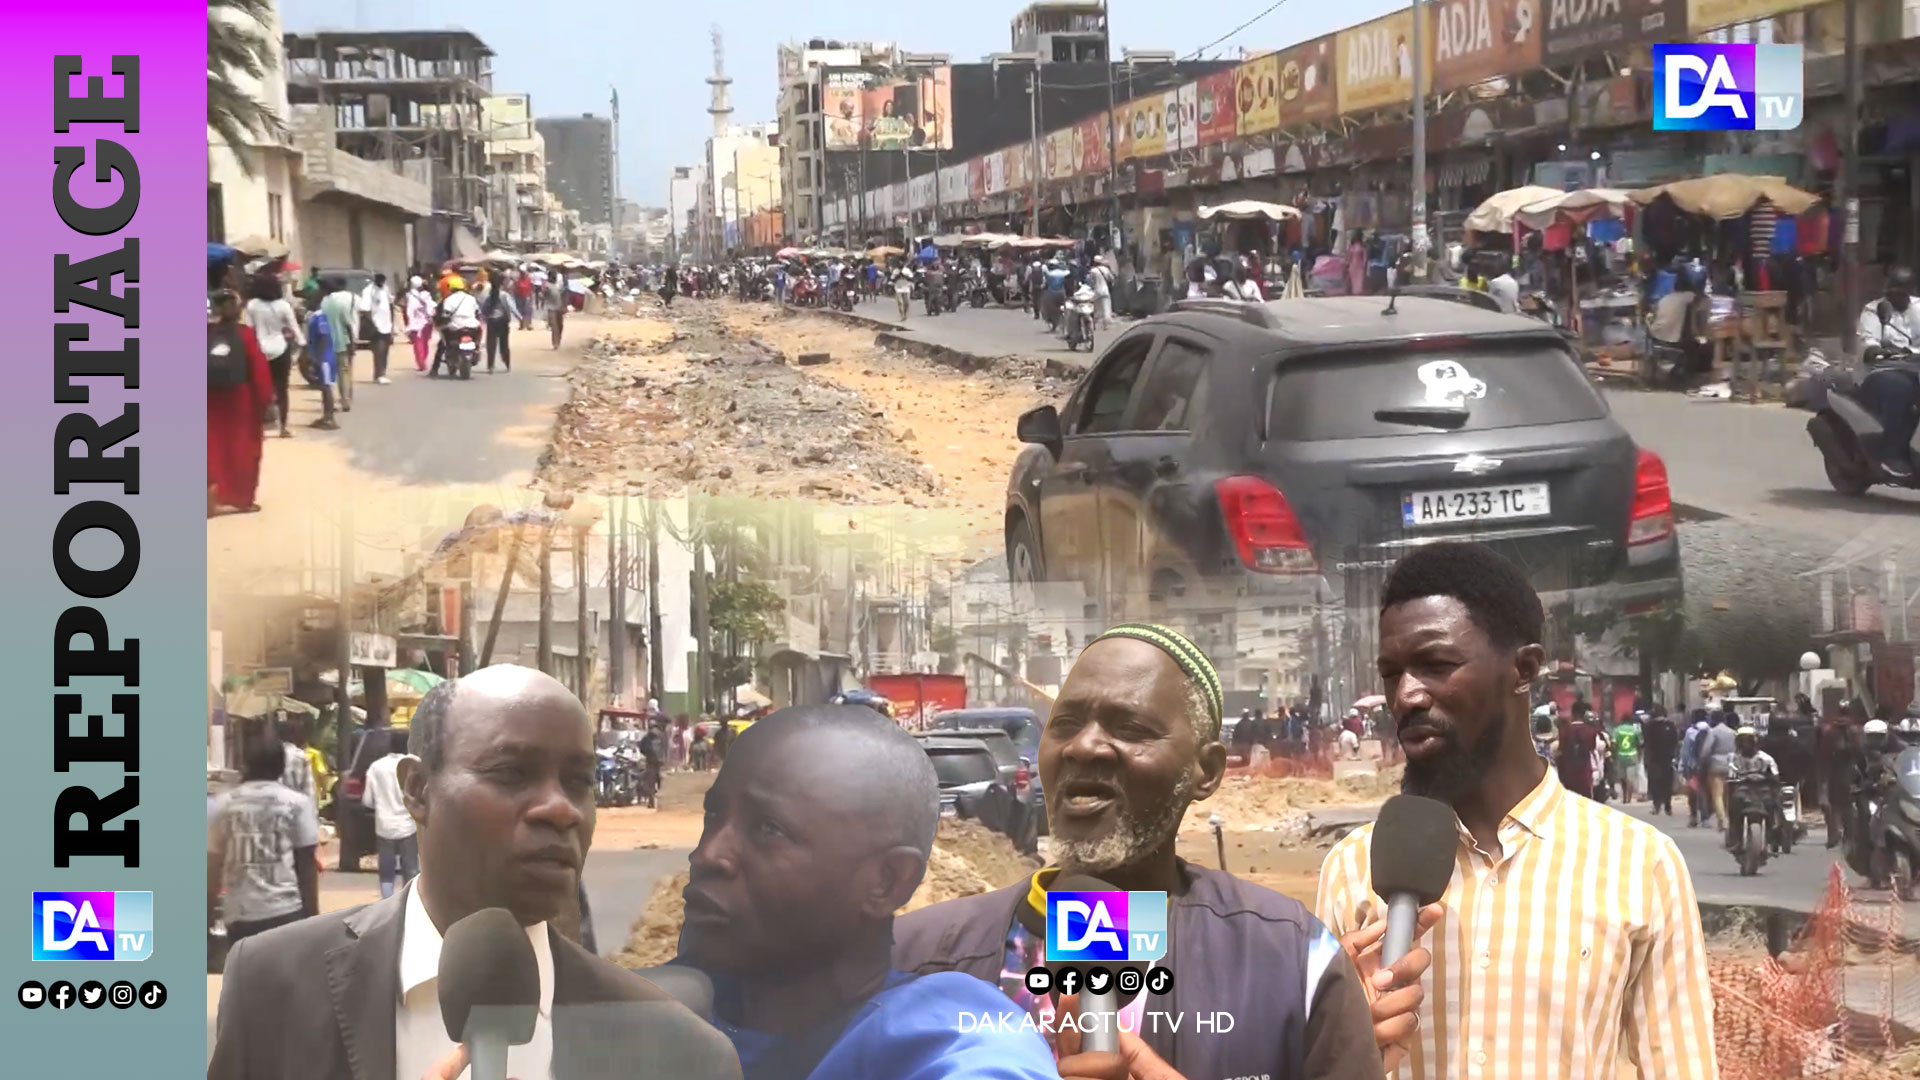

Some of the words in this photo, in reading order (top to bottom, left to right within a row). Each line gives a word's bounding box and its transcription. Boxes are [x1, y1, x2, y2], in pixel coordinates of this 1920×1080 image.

[1436, 0, 1492, 62] ADJA
[1347, 27, 1393, 85] ADJA
[1422, 489, 1525, 519] AA-233-TC
[1622, 736, 1631, 749] 6
